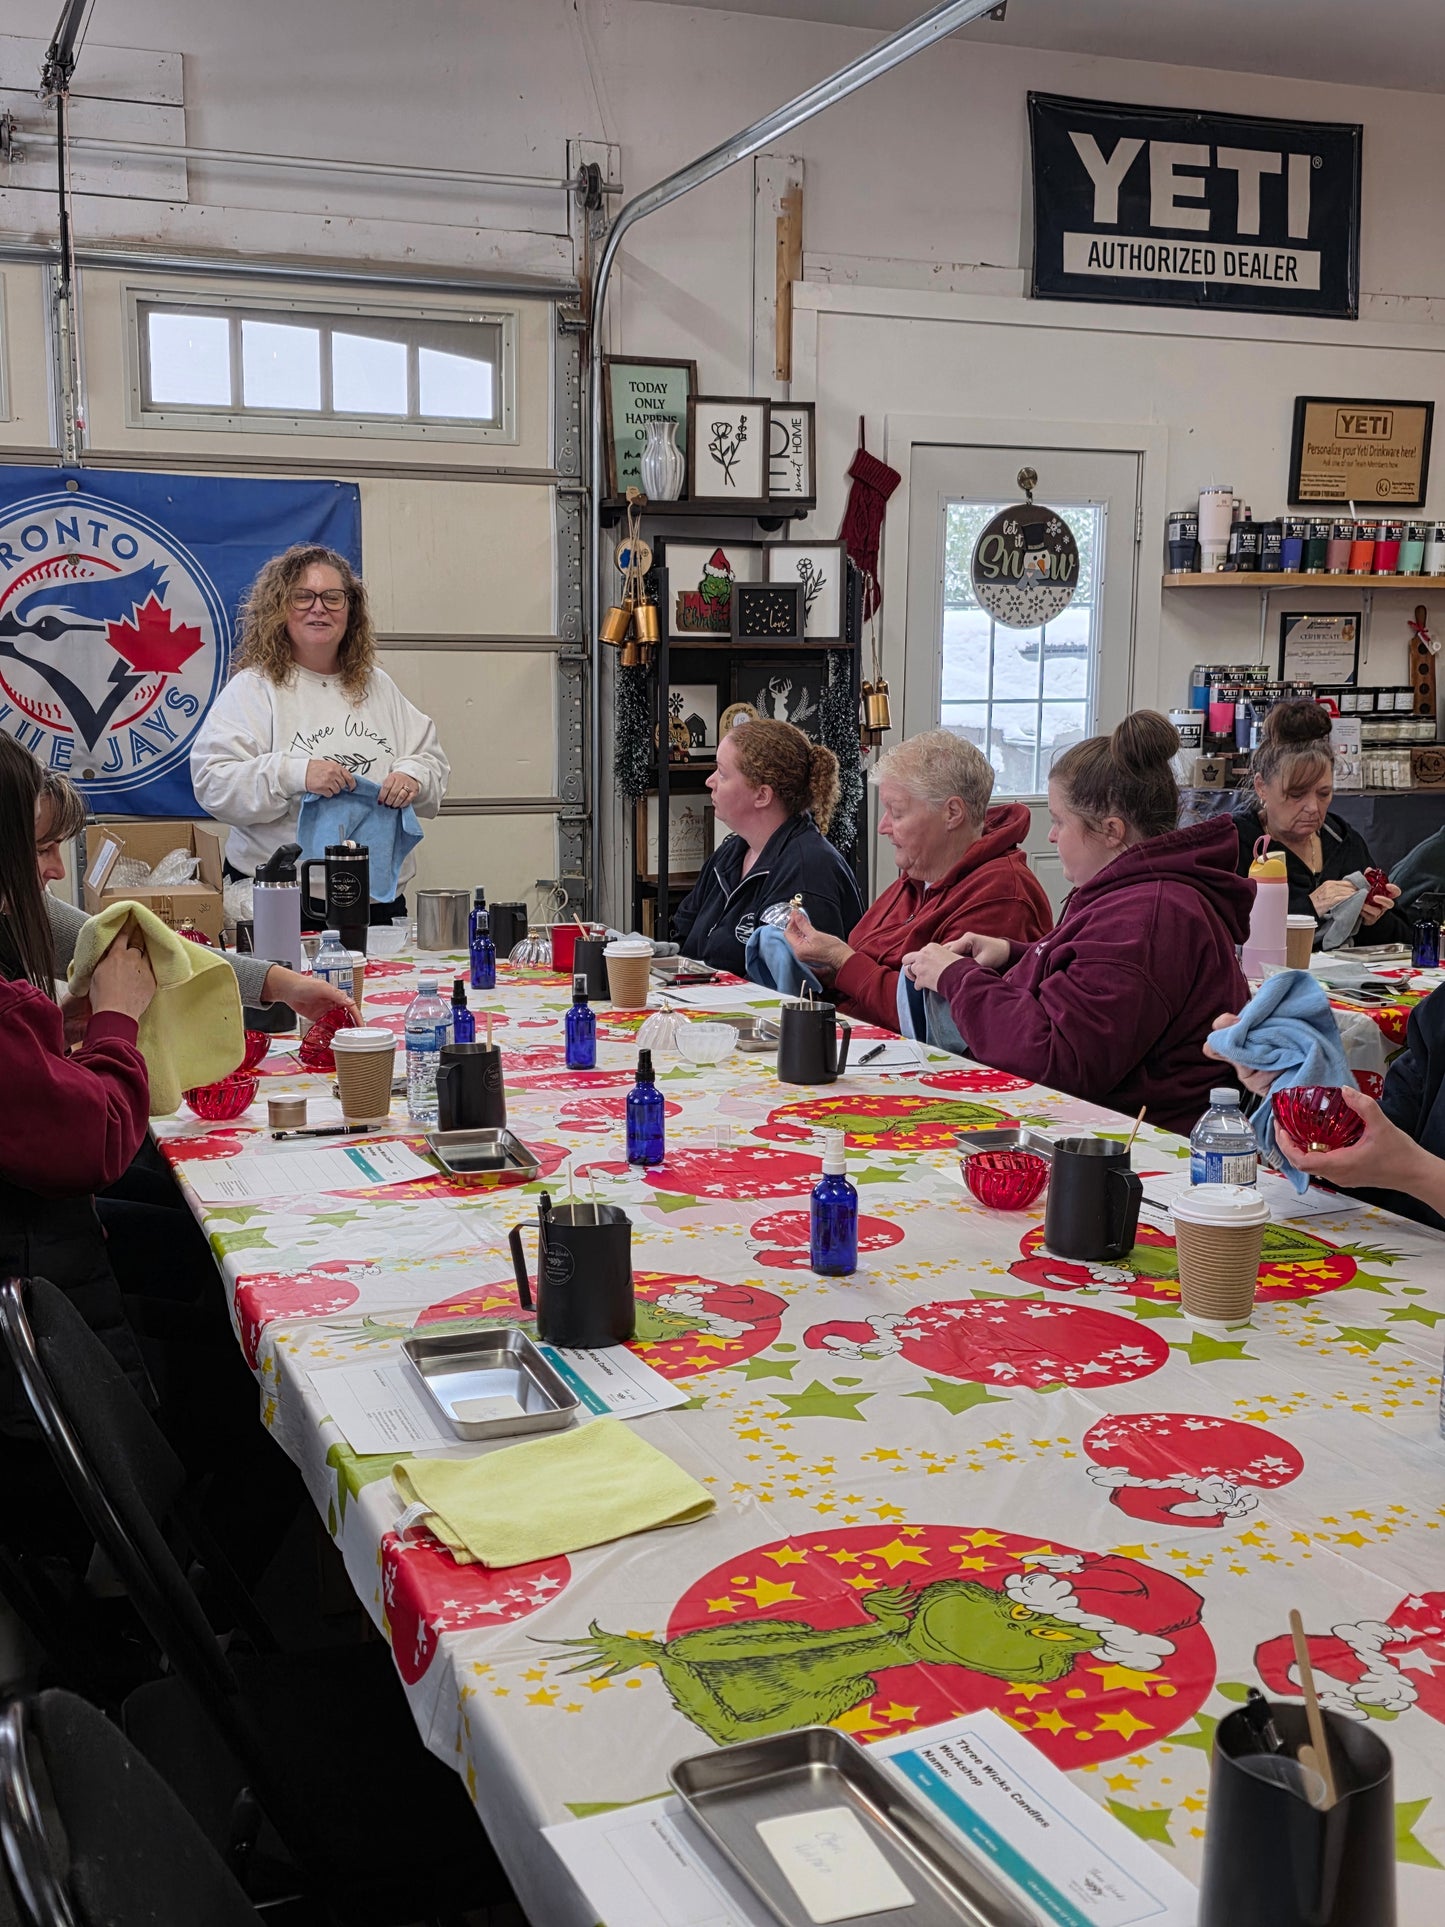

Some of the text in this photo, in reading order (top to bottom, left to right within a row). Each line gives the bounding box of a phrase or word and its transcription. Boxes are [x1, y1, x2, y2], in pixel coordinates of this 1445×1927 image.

[1068, 131, 1311, 240] YETI
[1087, 241, 1298, 282] AUTHORIZED DEALER
[629, 381, 668, 394] TODAY
[634, 398, 665, 410] ONLY
[625, 413, 677, 424] HAPPENS
[1341, 415, 1388, 435] YETI
[791, 418, 803, 454] HOME
[1003, 520, 1018, 535] let
[1015, 534, 1024, 548] it
[978, 534, 1076, 581] Snw
[769, 610, 789, 628] love
[101, 686, 200, 773] JAYS
[289, 714, 394, 757] Three Wicks
[1176, 725, 1200, 734] YETI
[922, 1750, 952, 1778] Name:
[939, 1744, 983, 1787] Workshop
[956, 1739, 1050, 1828] Three Wicks Candles
